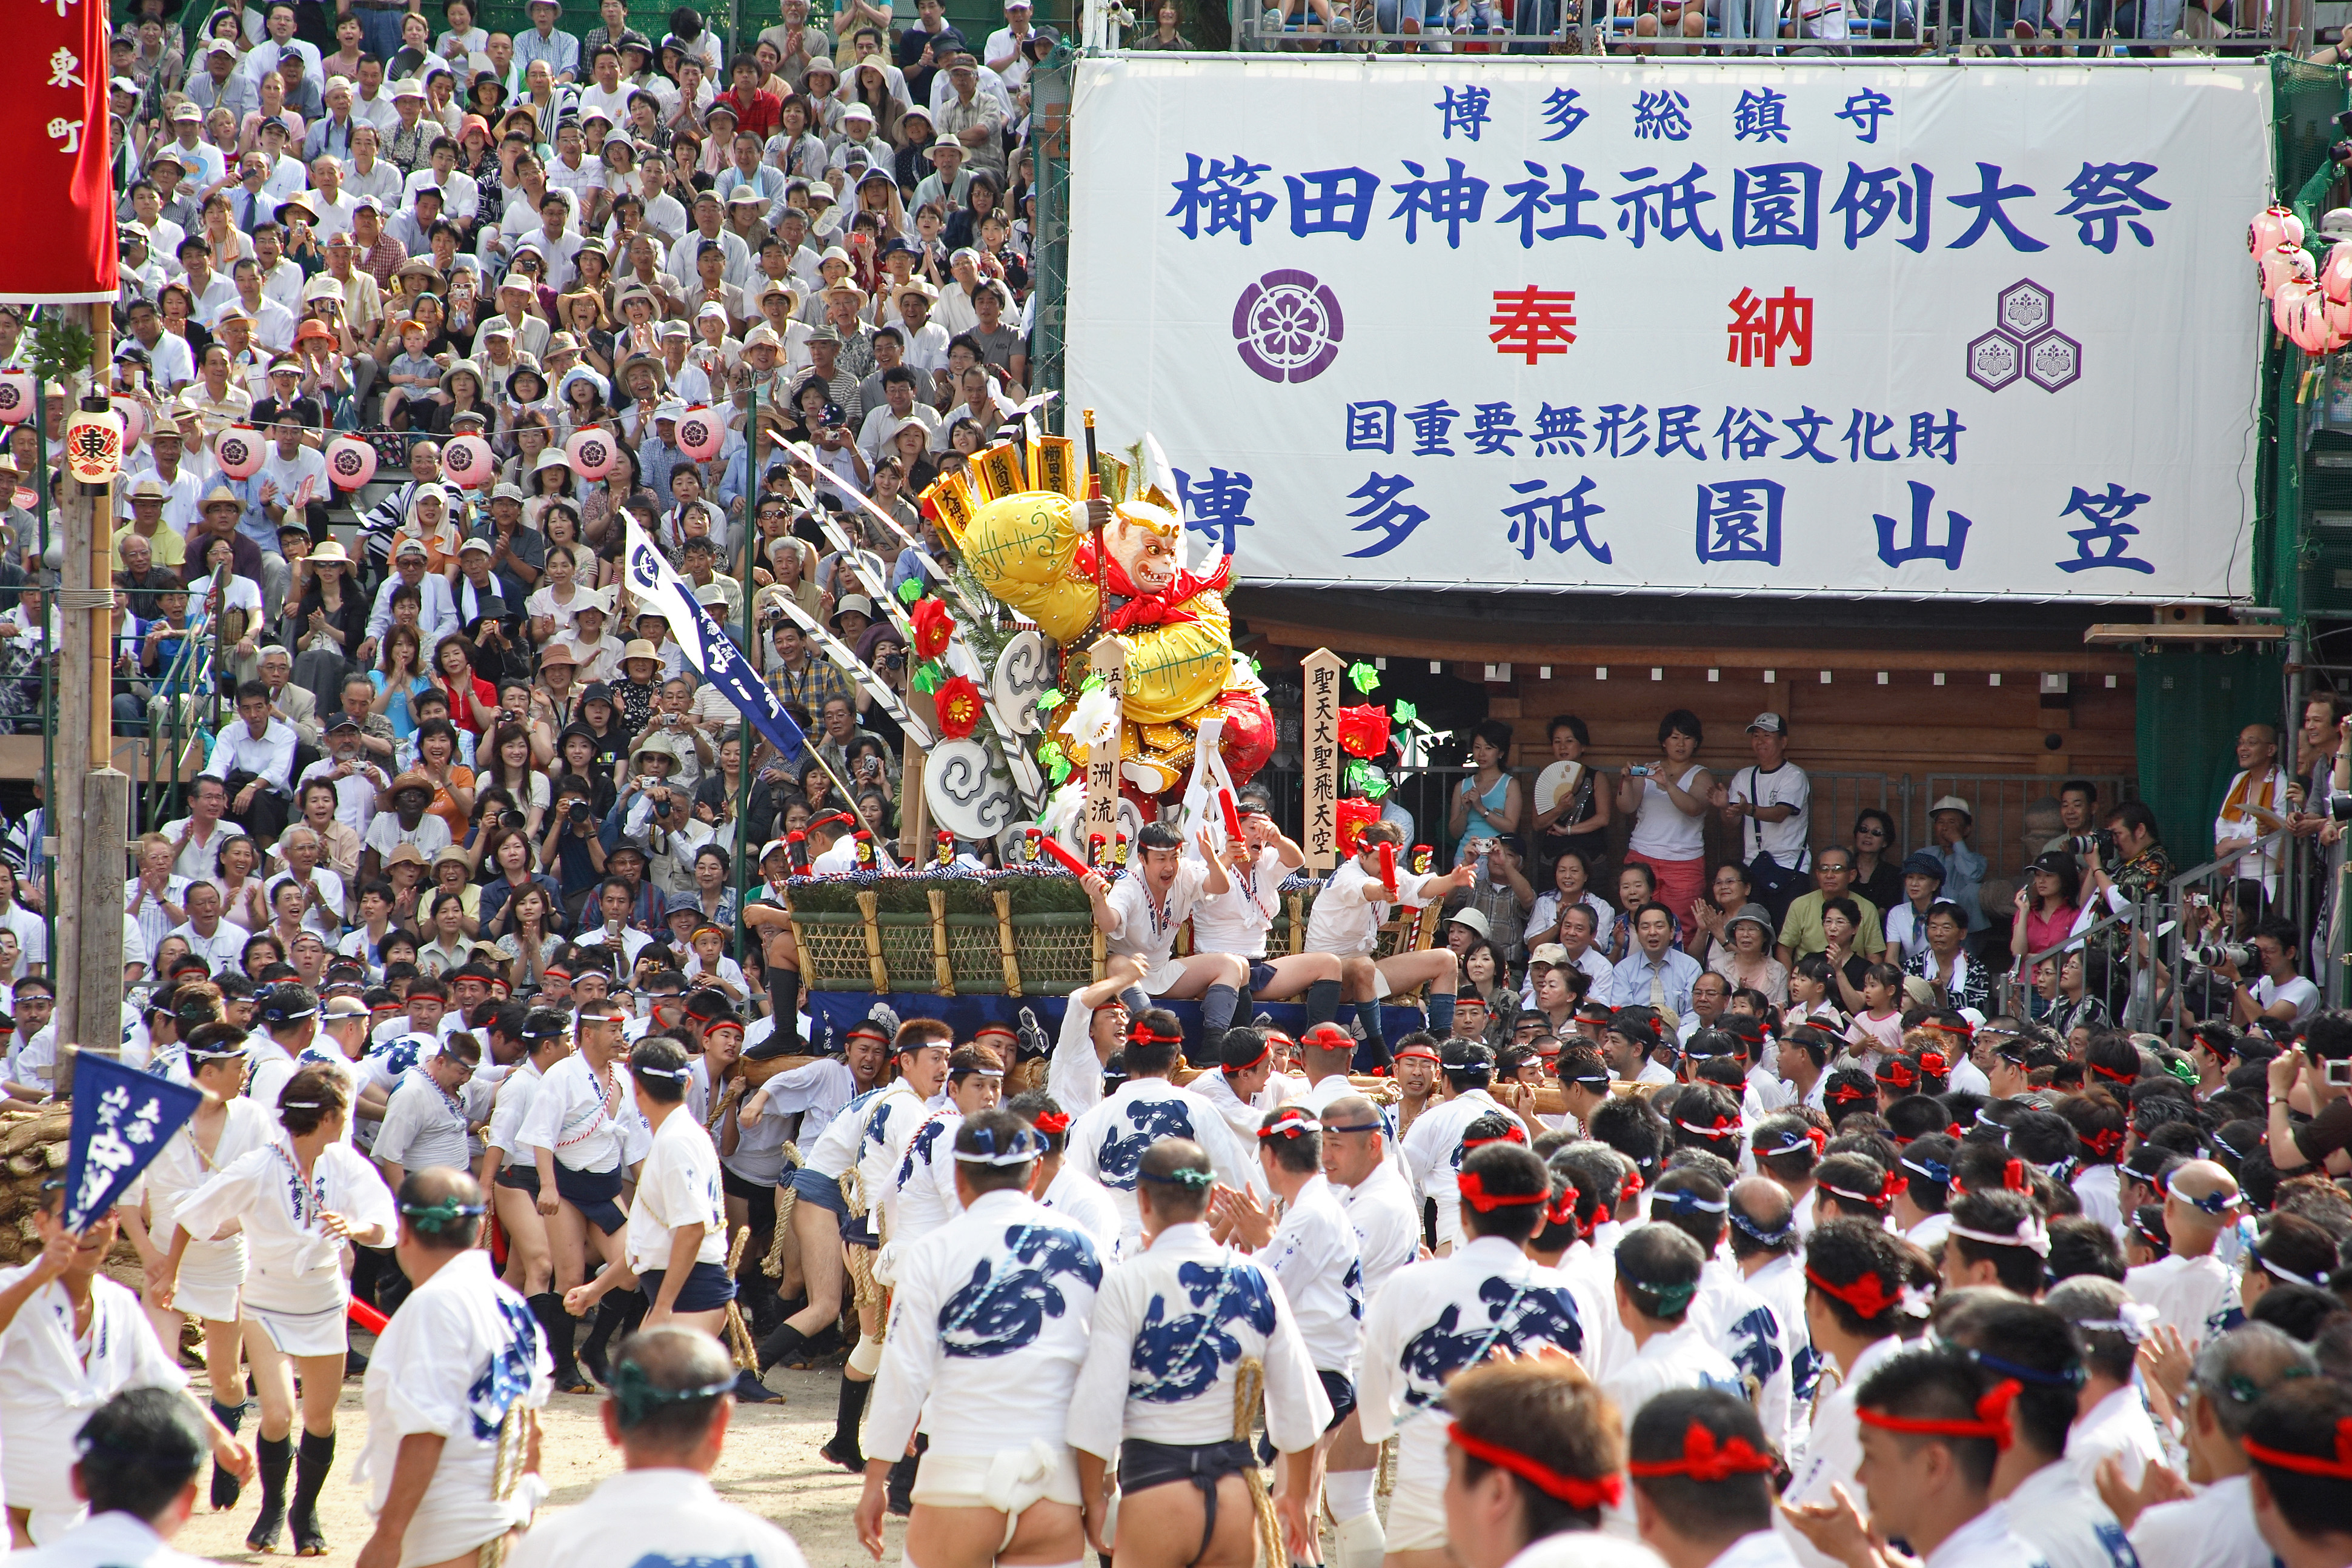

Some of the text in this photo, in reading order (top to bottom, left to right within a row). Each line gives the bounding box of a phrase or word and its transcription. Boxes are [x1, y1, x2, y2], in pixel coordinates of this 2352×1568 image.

[1434, 84, 1894, 144] 博多総鎮守
[1166, 153, 2171, 254] 櫛田神社祇園例大祭
[1489, 285, 1813, 368] 奉納
[78, 428, 108, 459] 東
[1346, 399, 1967, 464] 国重要無形民俗文化財
[1043, 445, 1062, 493] 櫛田宮
[942, 489, 966, 530] 大神宮
[1172, 467, 2154, 576] 博多祇園山笠
[1091, 728, 1115, 823] 洲流
[1312, 667, 1335, 855] 聖天大聖飛天空
